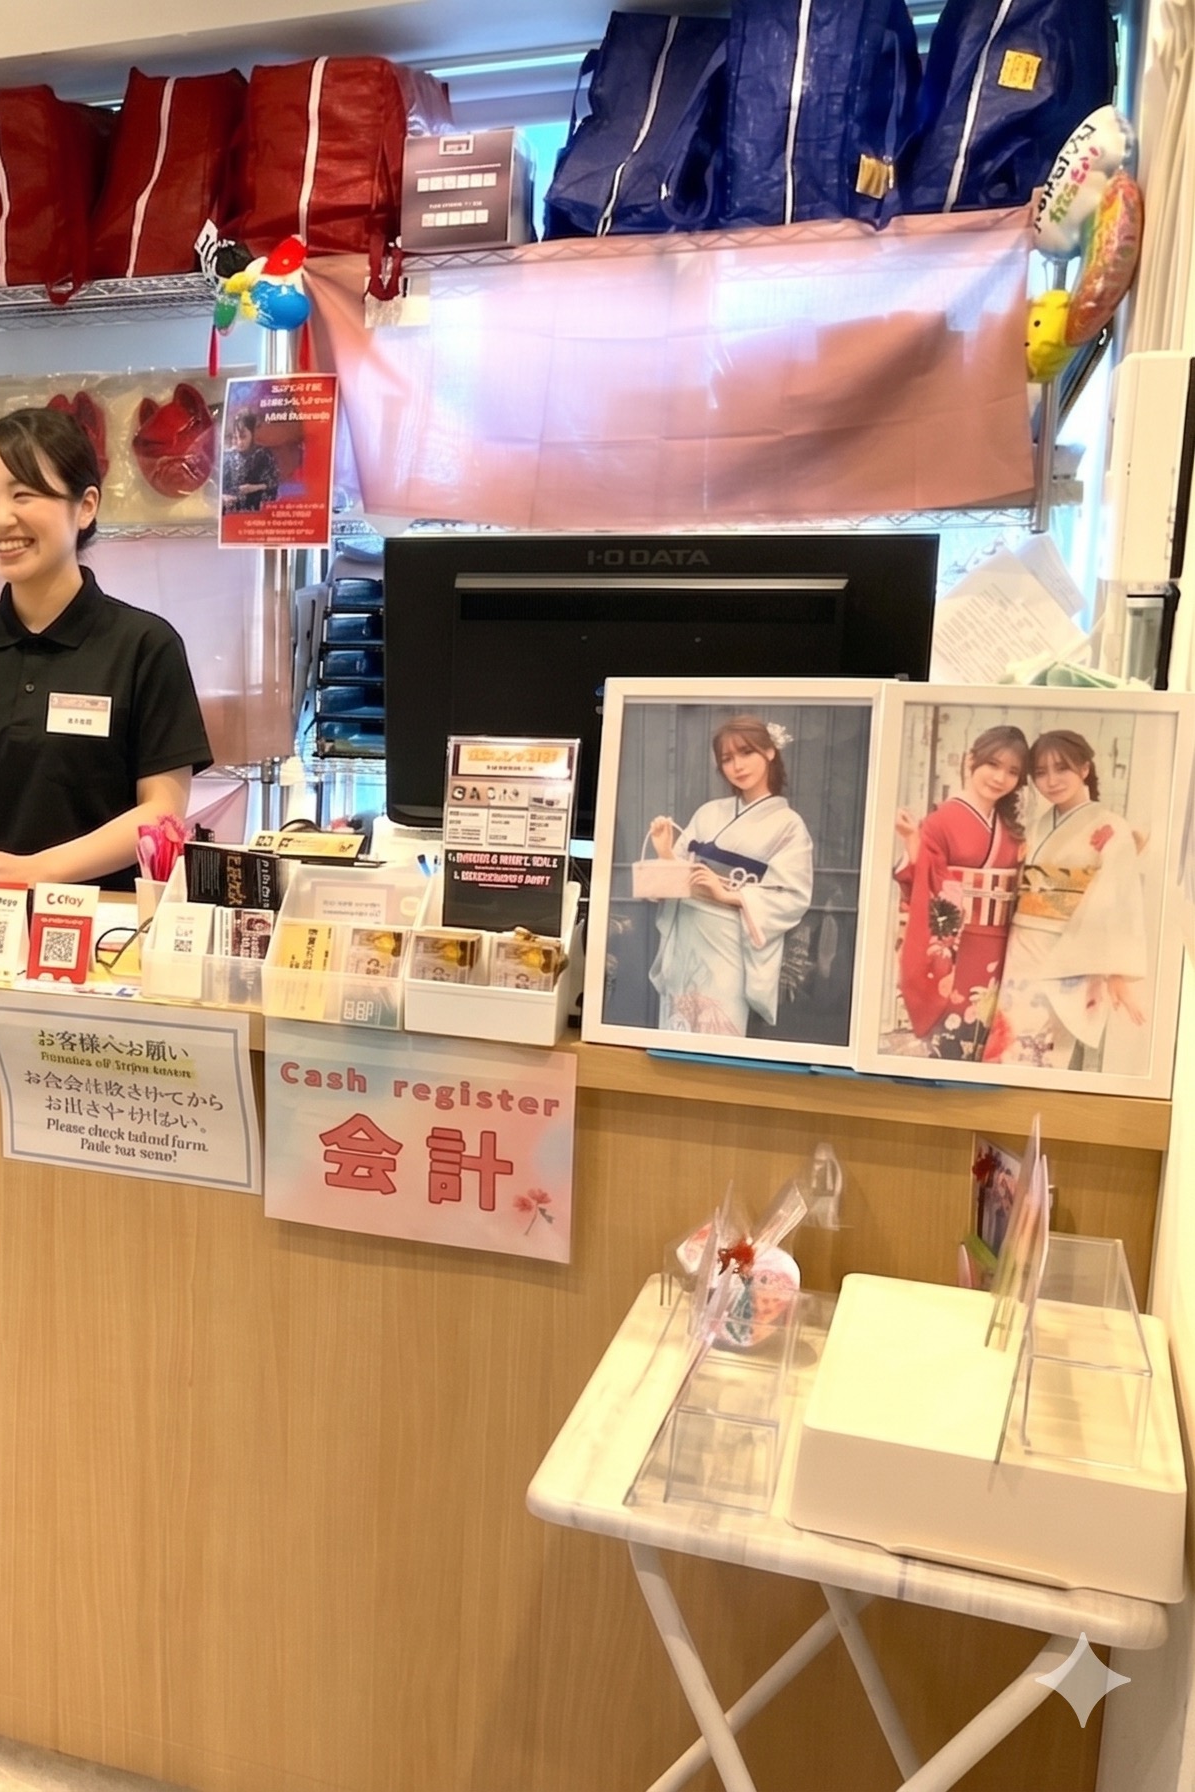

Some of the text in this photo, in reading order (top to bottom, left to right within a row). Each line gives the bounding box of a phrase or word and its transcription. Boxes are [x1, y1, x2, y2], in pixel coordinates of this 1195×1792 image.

[629, 549, 711, 566] DATA
[280, 1061, 560, 1117] Cash register
[46, 1117, 85, 1135] Please
[88, 1124, 125, 1141] check
[318, 1113, 513, 1211] 会計
